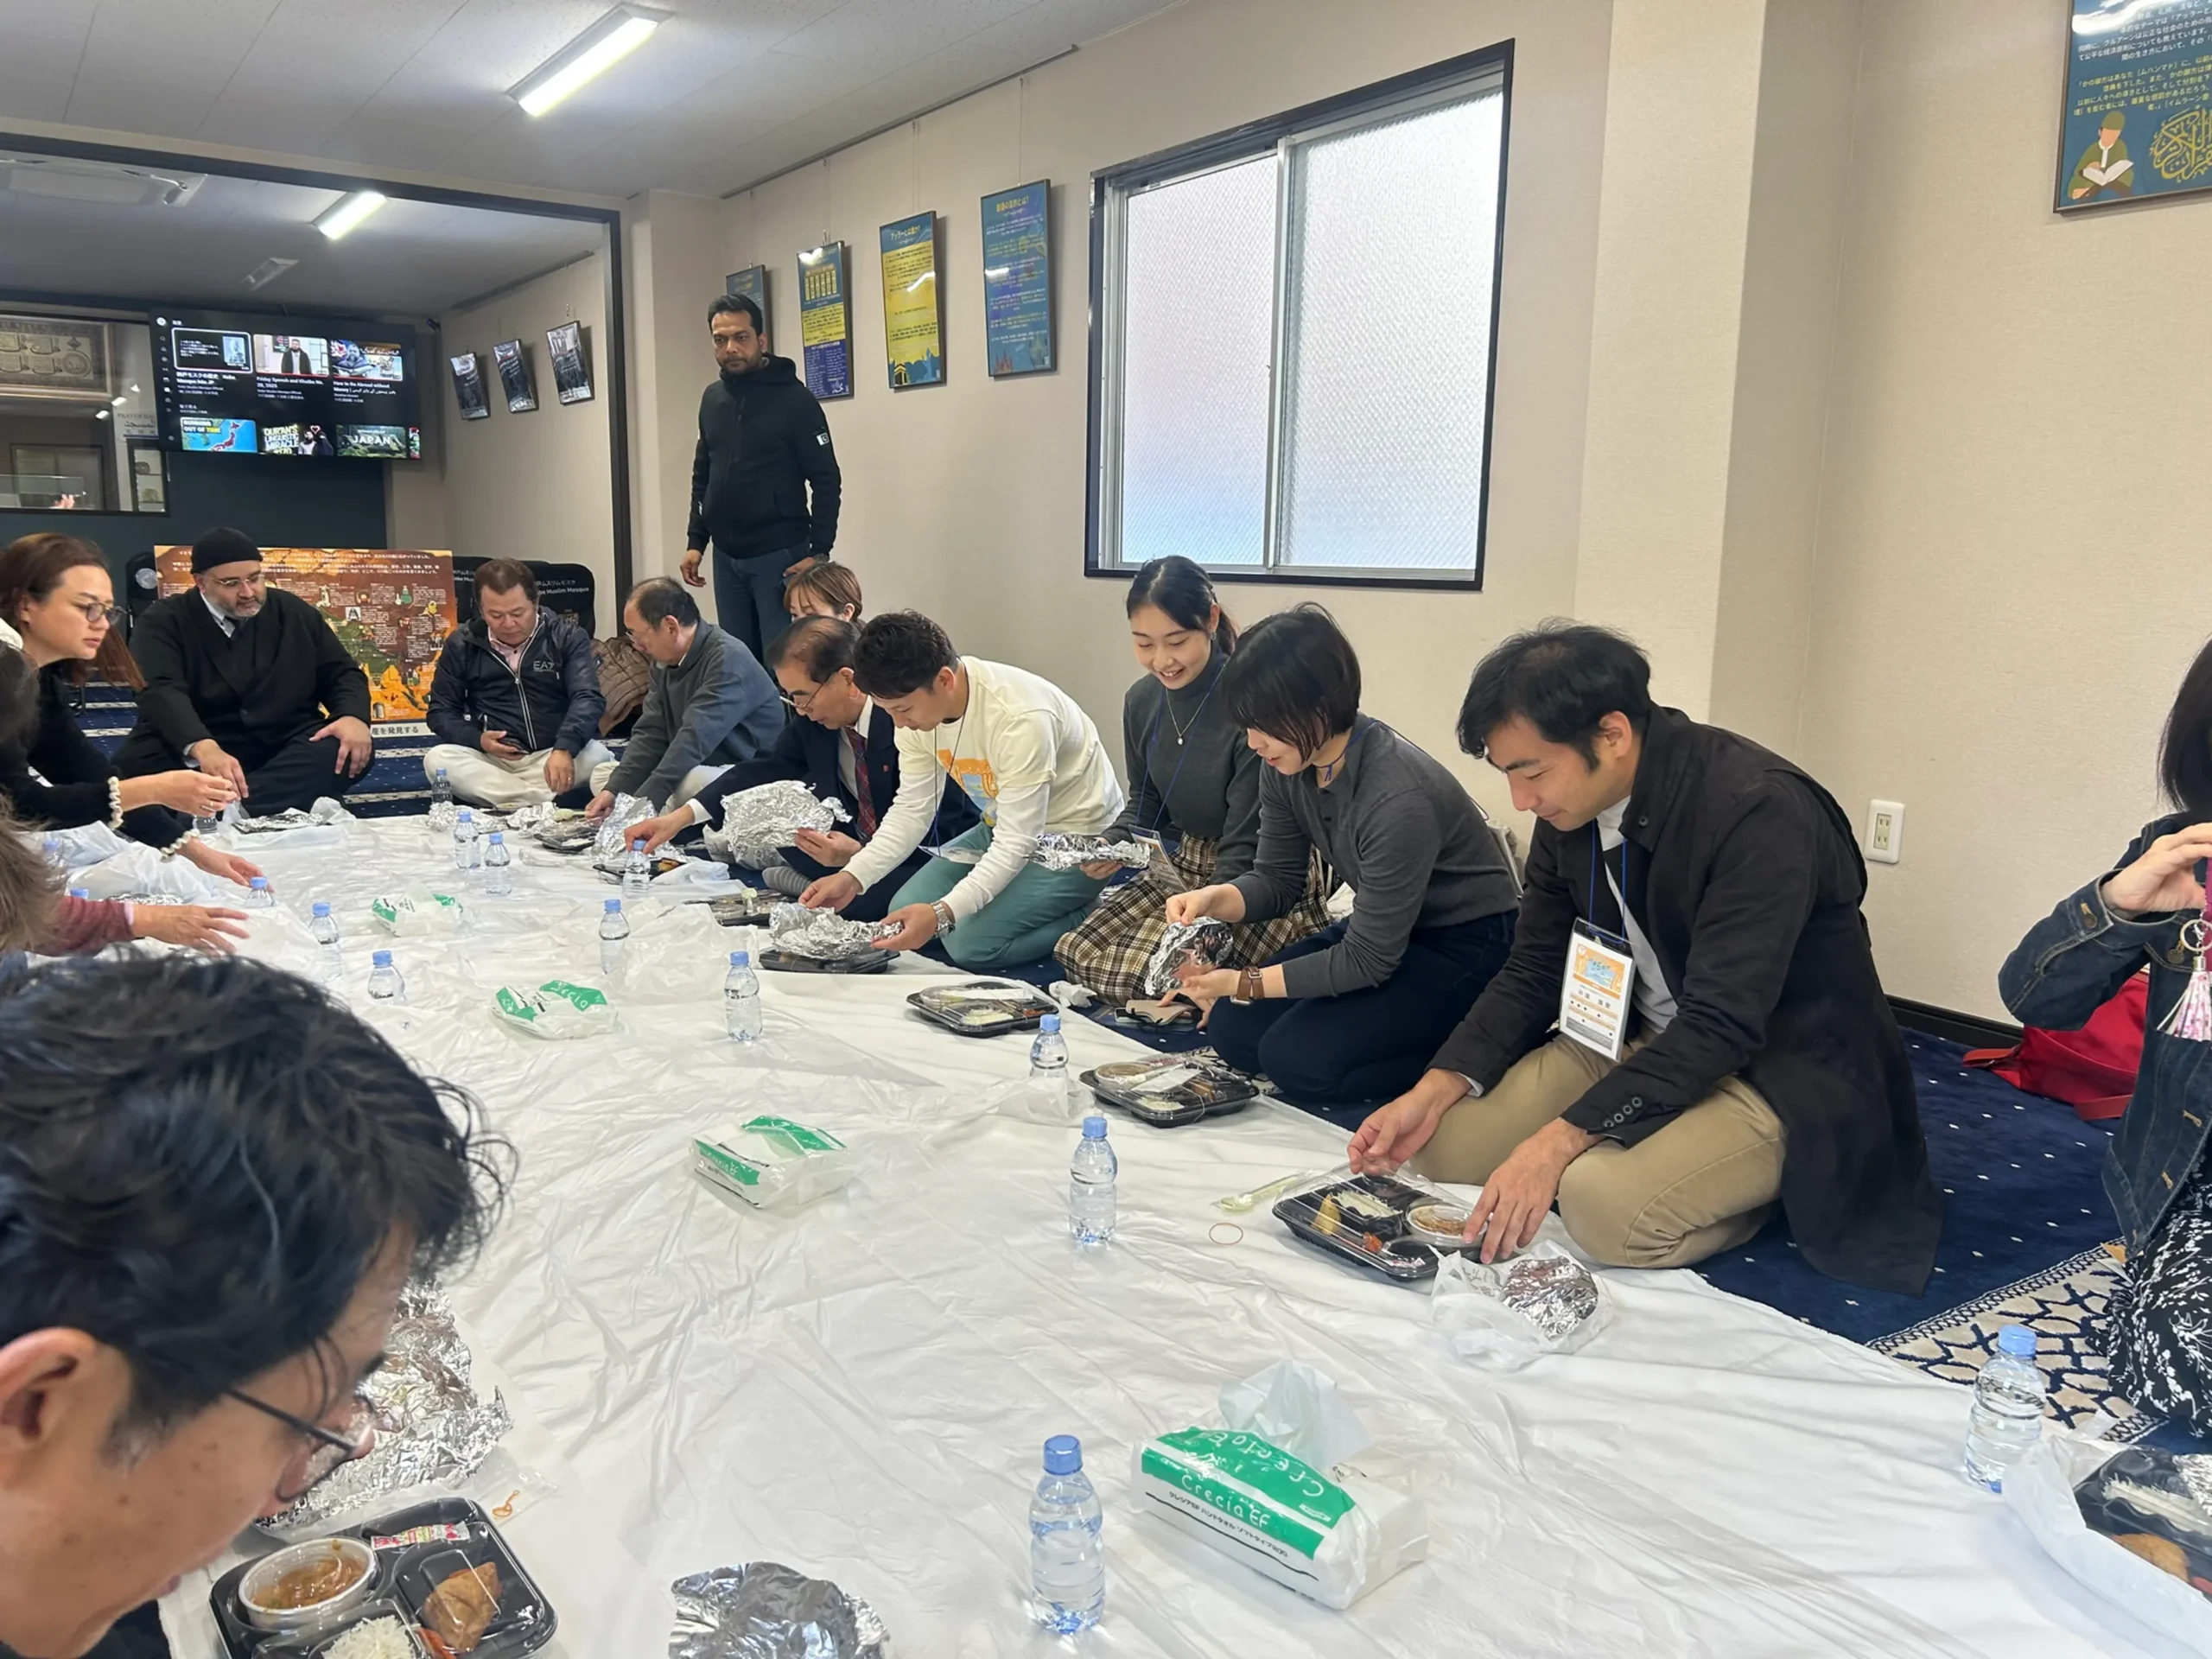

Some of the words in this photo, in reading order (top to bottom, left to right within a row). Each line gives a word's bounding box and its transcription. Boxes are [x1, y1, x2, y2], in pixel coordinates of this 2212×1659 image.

[353, 435, 391, 446] JAPAN
[532, 660, 555, 671] EA7
[1181, 1474, 1244, 1518] Crecia
[1249, 1508, 1271, 1529] EF
